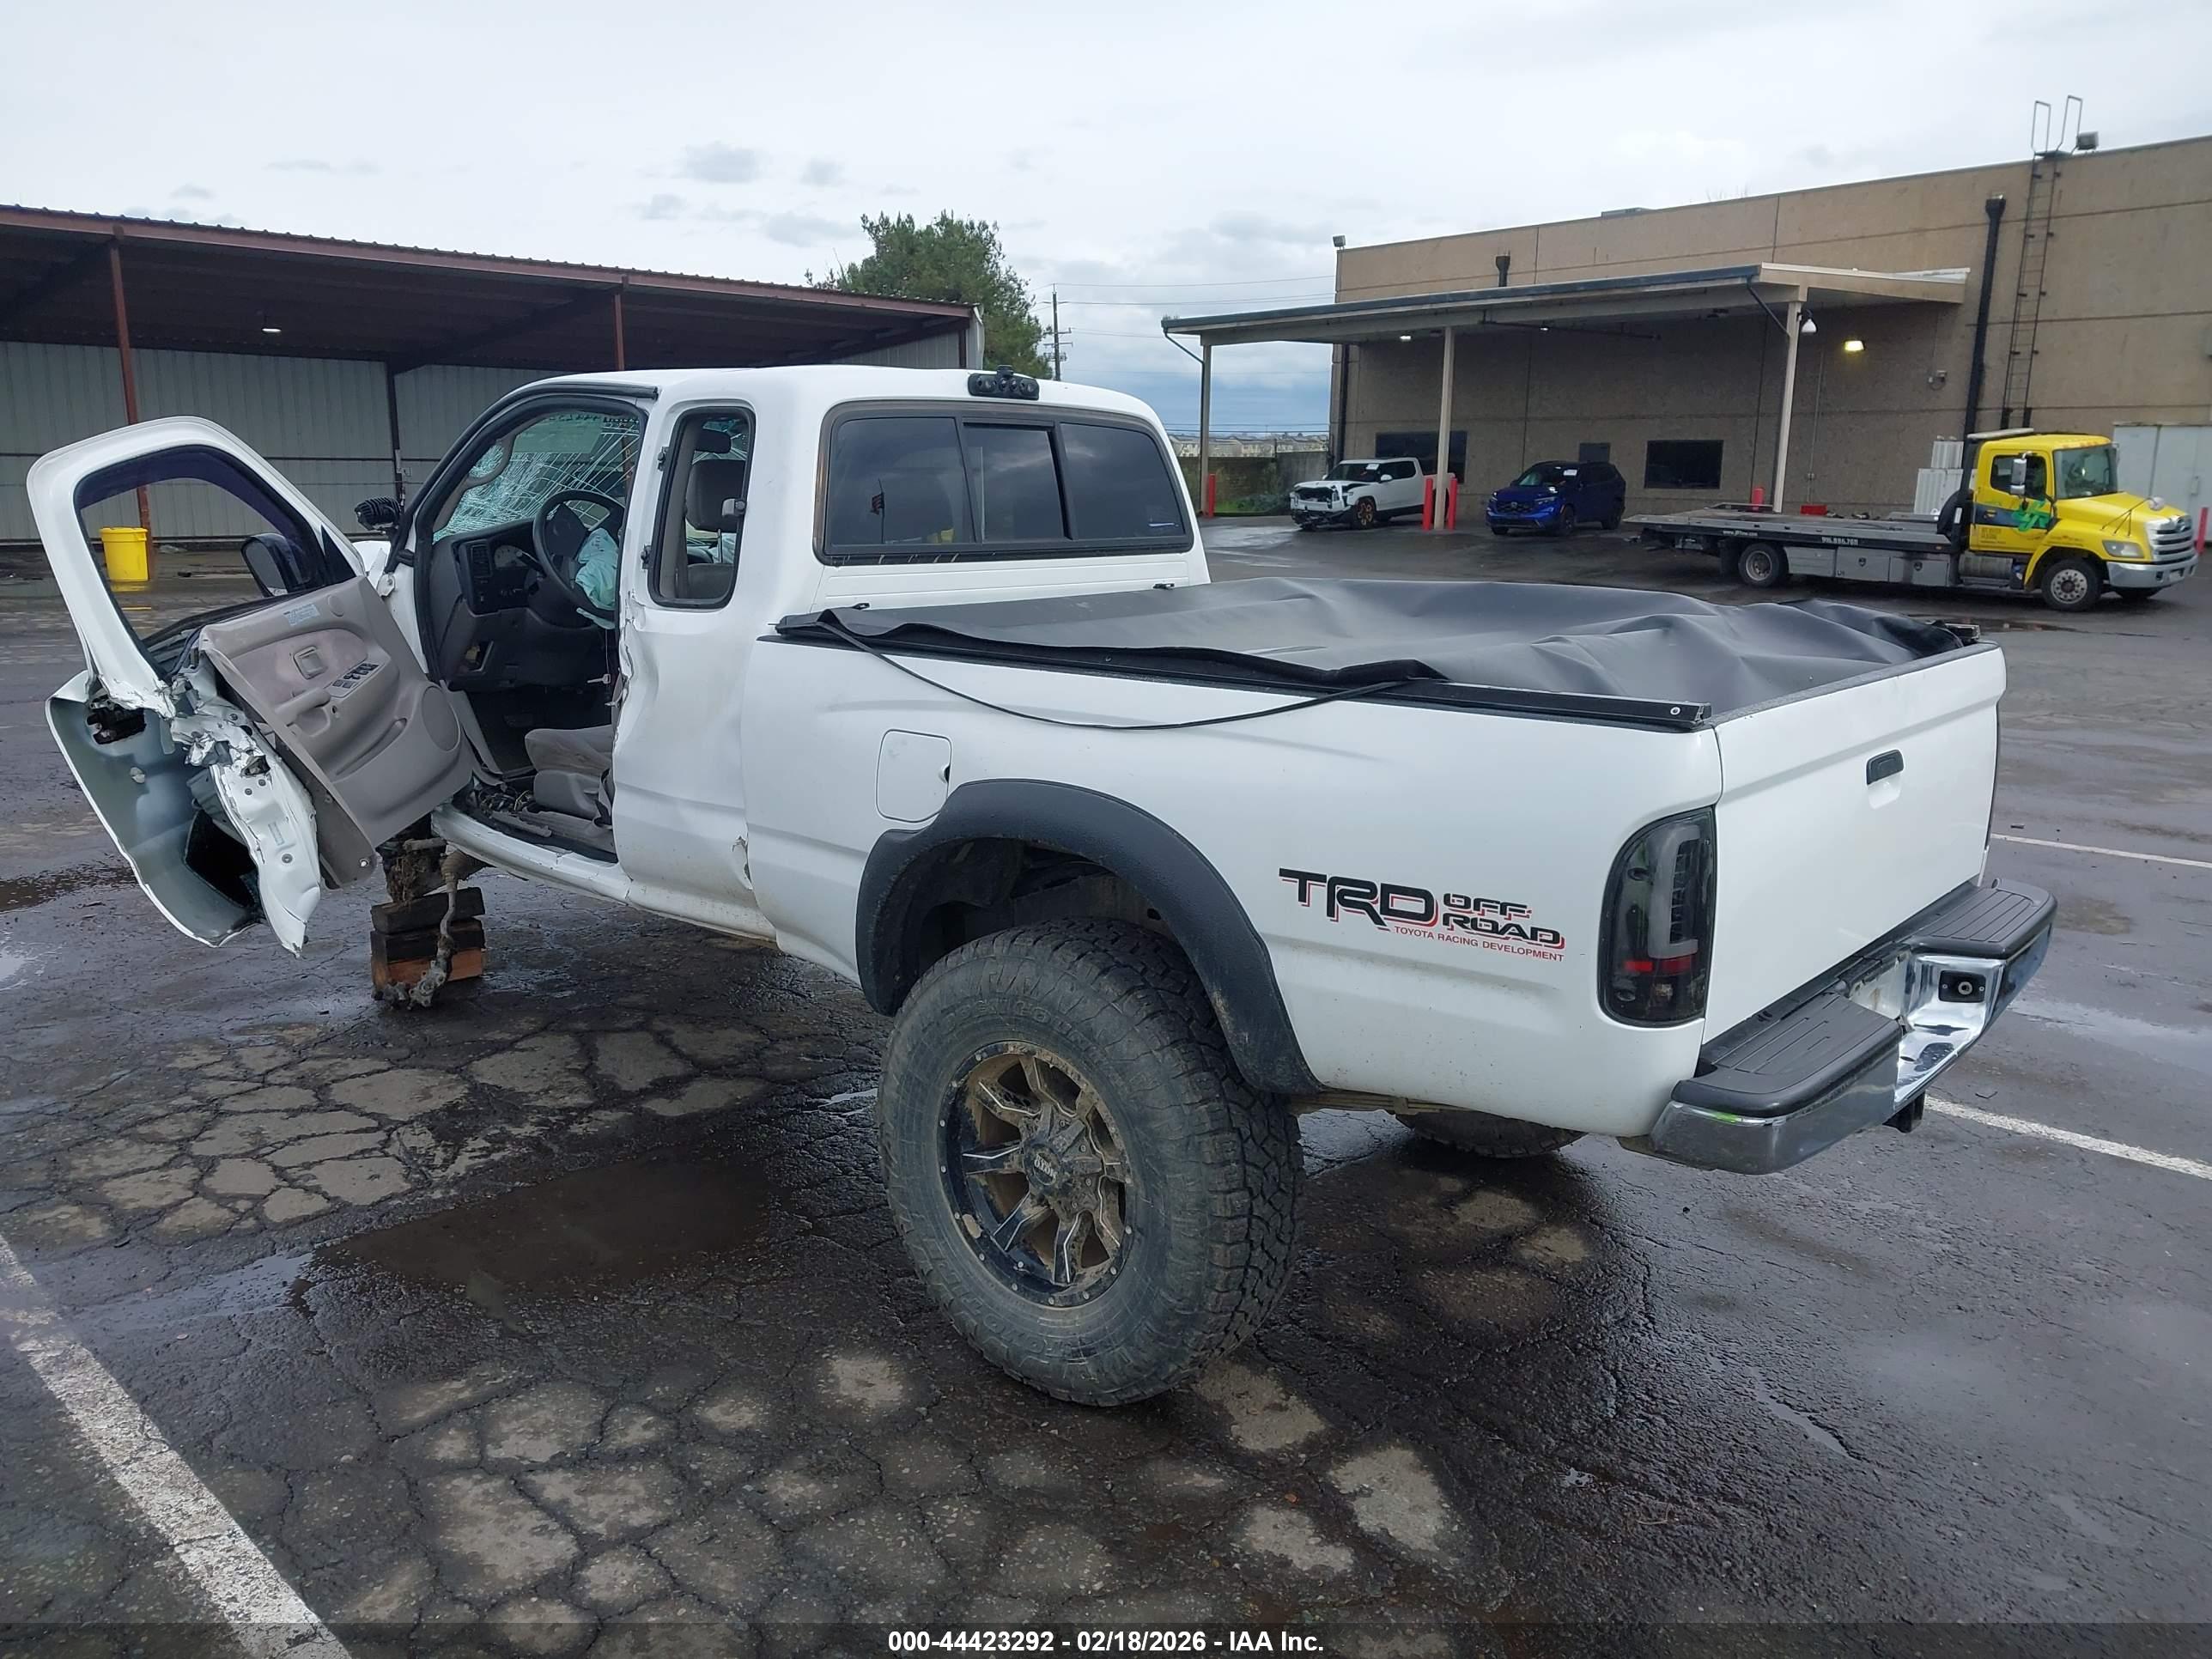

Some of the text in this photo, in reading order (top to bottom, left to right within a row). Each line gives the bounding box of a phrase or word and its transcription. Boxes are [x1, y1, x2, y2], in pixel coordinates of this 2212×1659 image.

[1279, 867, 1439, 932] TRD
[1443, 892, 1532, 921] OFF
[1394, 926, 1565, 962] TOYOTA RACING DEVELOPMENT
[1442, 912, 1565, 950] ROAD
